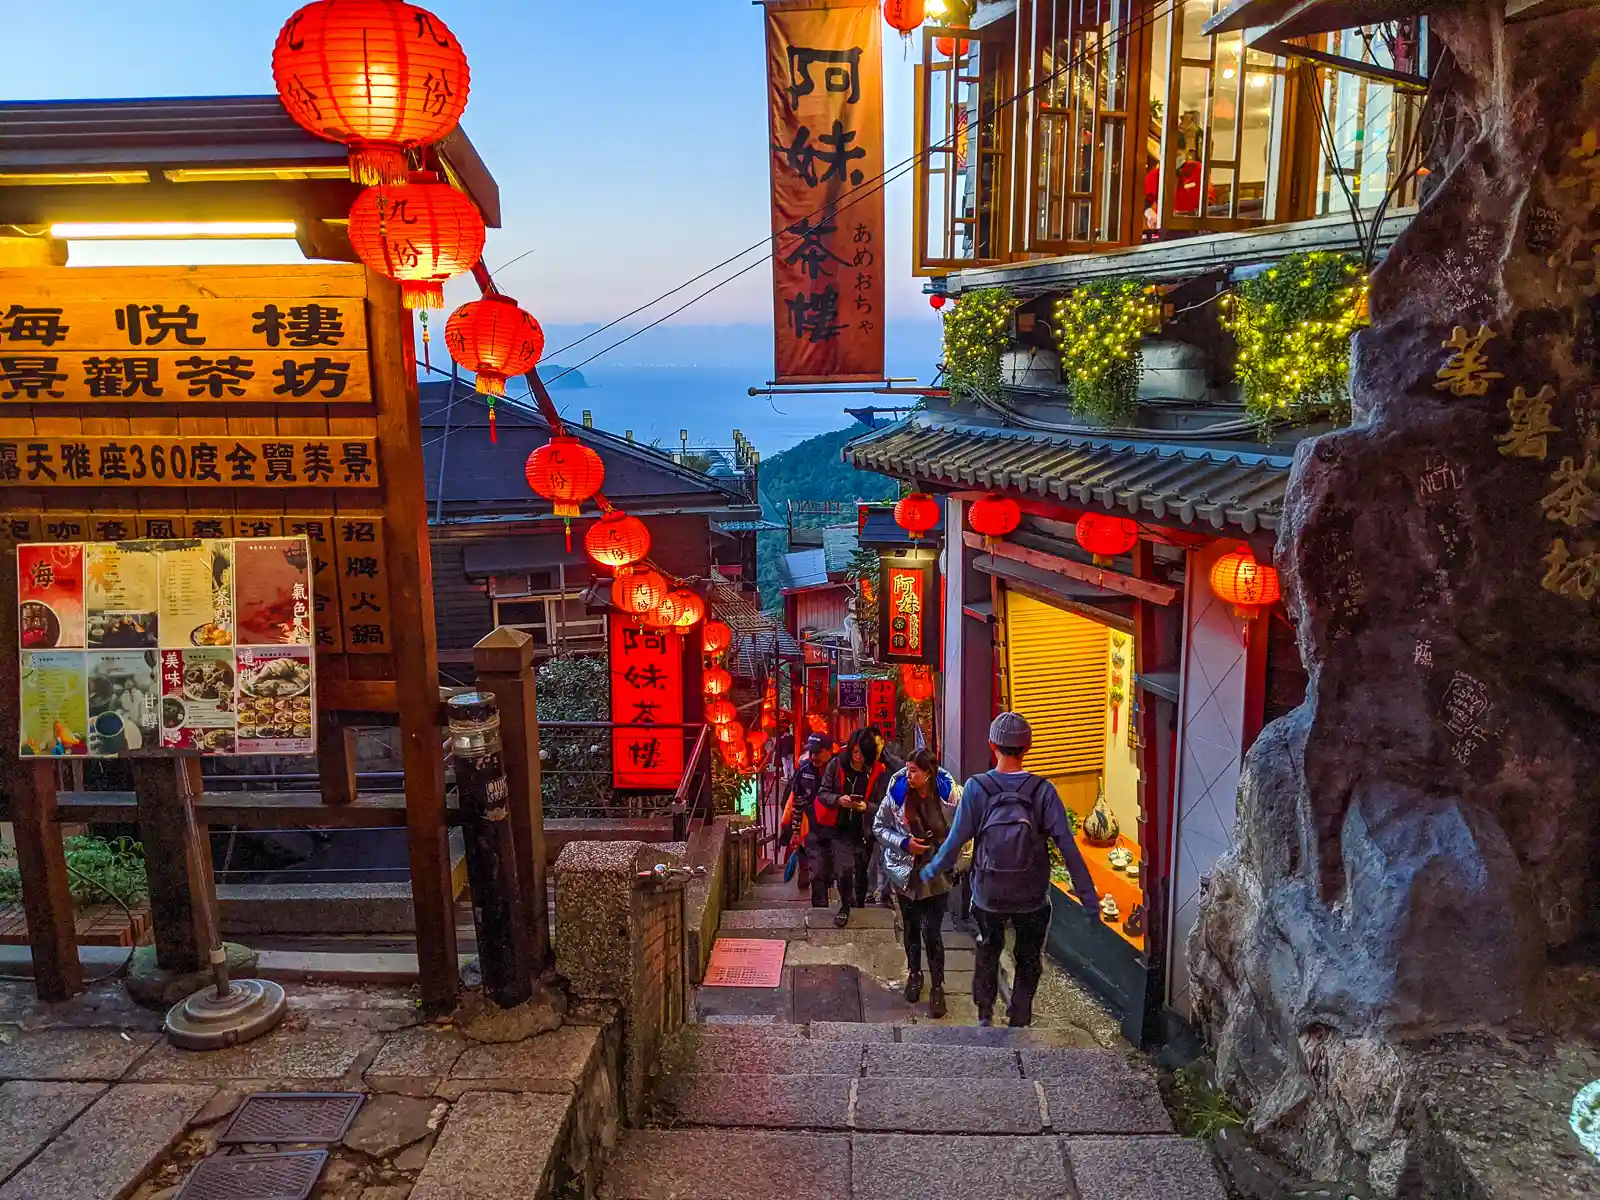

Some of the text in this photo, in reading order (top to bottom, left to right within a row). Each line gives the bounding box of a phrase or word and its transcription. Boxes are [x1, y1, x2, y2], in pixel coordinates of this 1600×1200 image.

[413, 12, 454, 117] 九份
[772, 46, 866, 343] 阿妹茶樓
[389, 199, 423, 268] 九份
[852, 223, 874, 335] あめおちゃ
[0, 304, 345, 347] 海悅樓
[519, 311, 538, 361] 九份
[0, 355, 350, 398] 景觀茶坊
[550, 450, 567, 489] 九份
[608, 529, 624, 561] 九份
[31, 559, 54, 589] 海
[342, 521, 385, 646] 招牌火鍋
[893, 573, 920, 614] 阿妹
[634, 583, 650, 611] 九份
[659, 600, 672, 624] 九份
[164, 652, 182, 687] 美味
[622, 628, 668, 770] 阿妹茶樓
